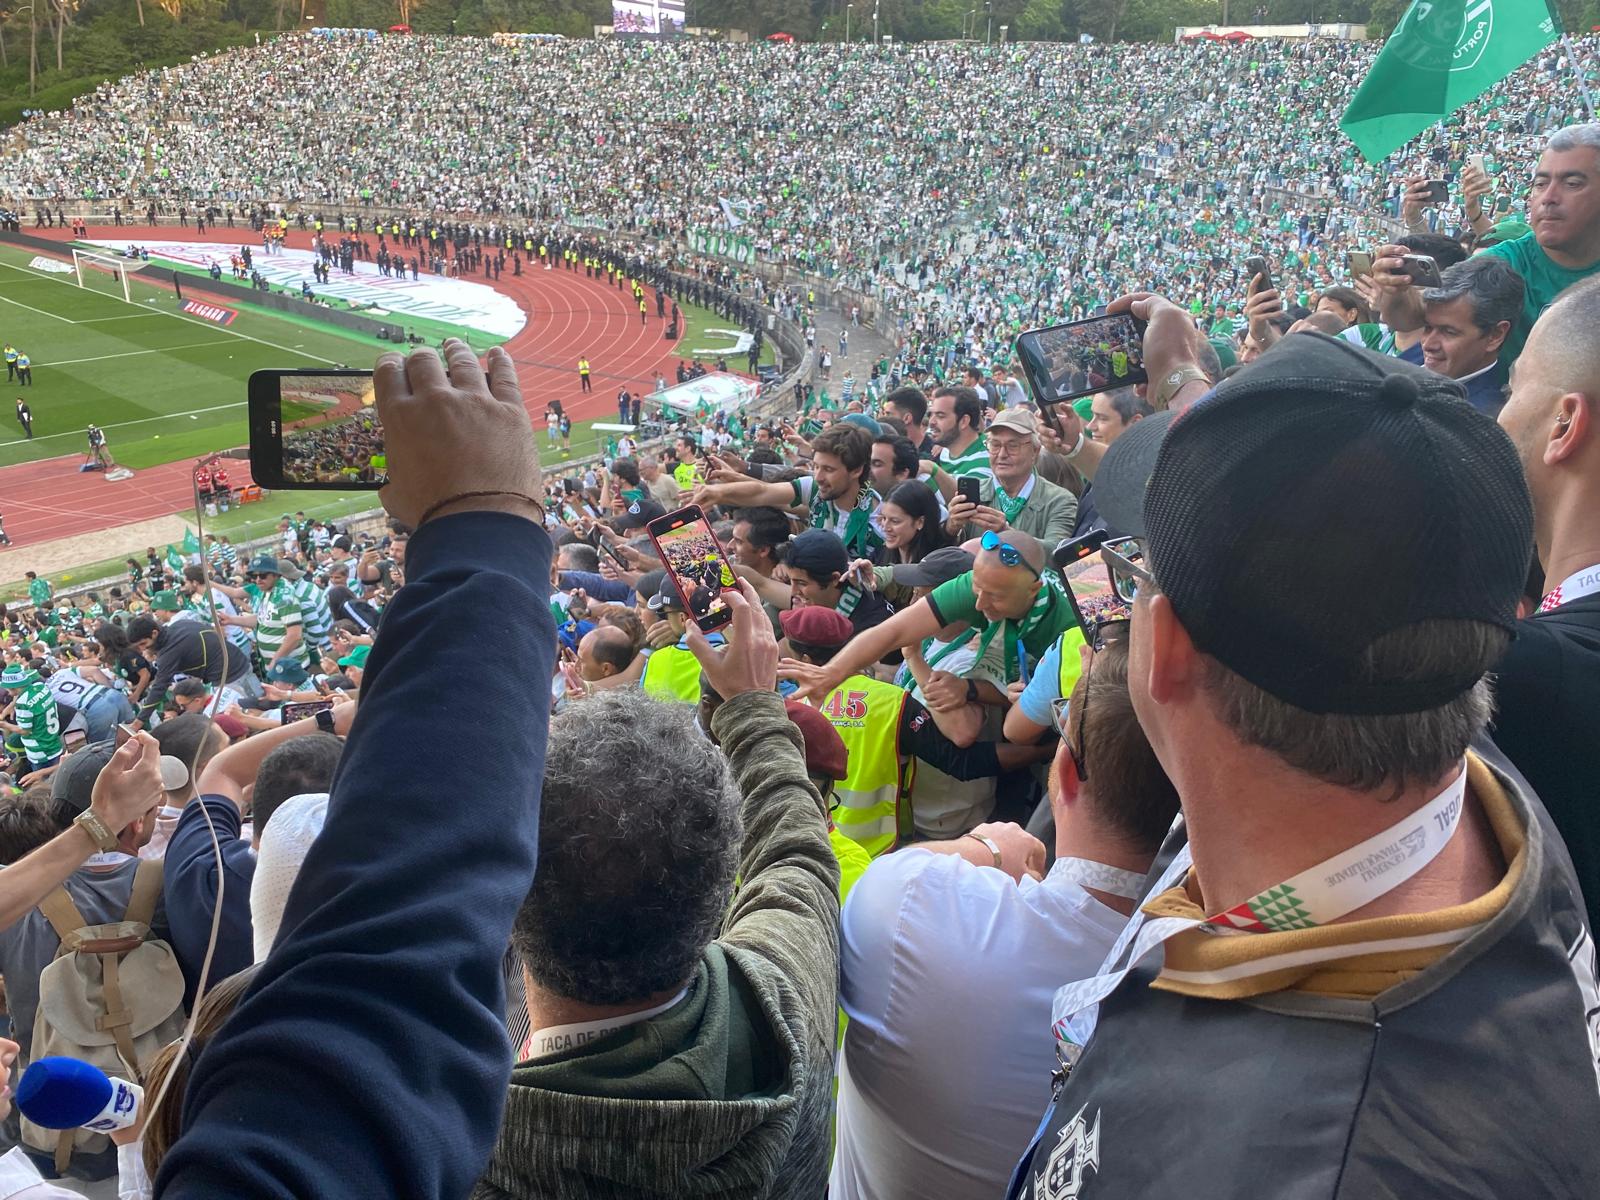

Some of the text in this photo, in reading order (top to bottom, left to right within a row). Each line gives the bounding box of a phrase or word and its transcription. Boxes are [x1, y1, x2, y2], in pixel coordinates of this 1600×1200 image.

[183, 300, 226, 321] PLACARD
[1324, 841, 1402, 888] TRANQUILIDADE
[1361, 851, 1406, 883] GENERALI
